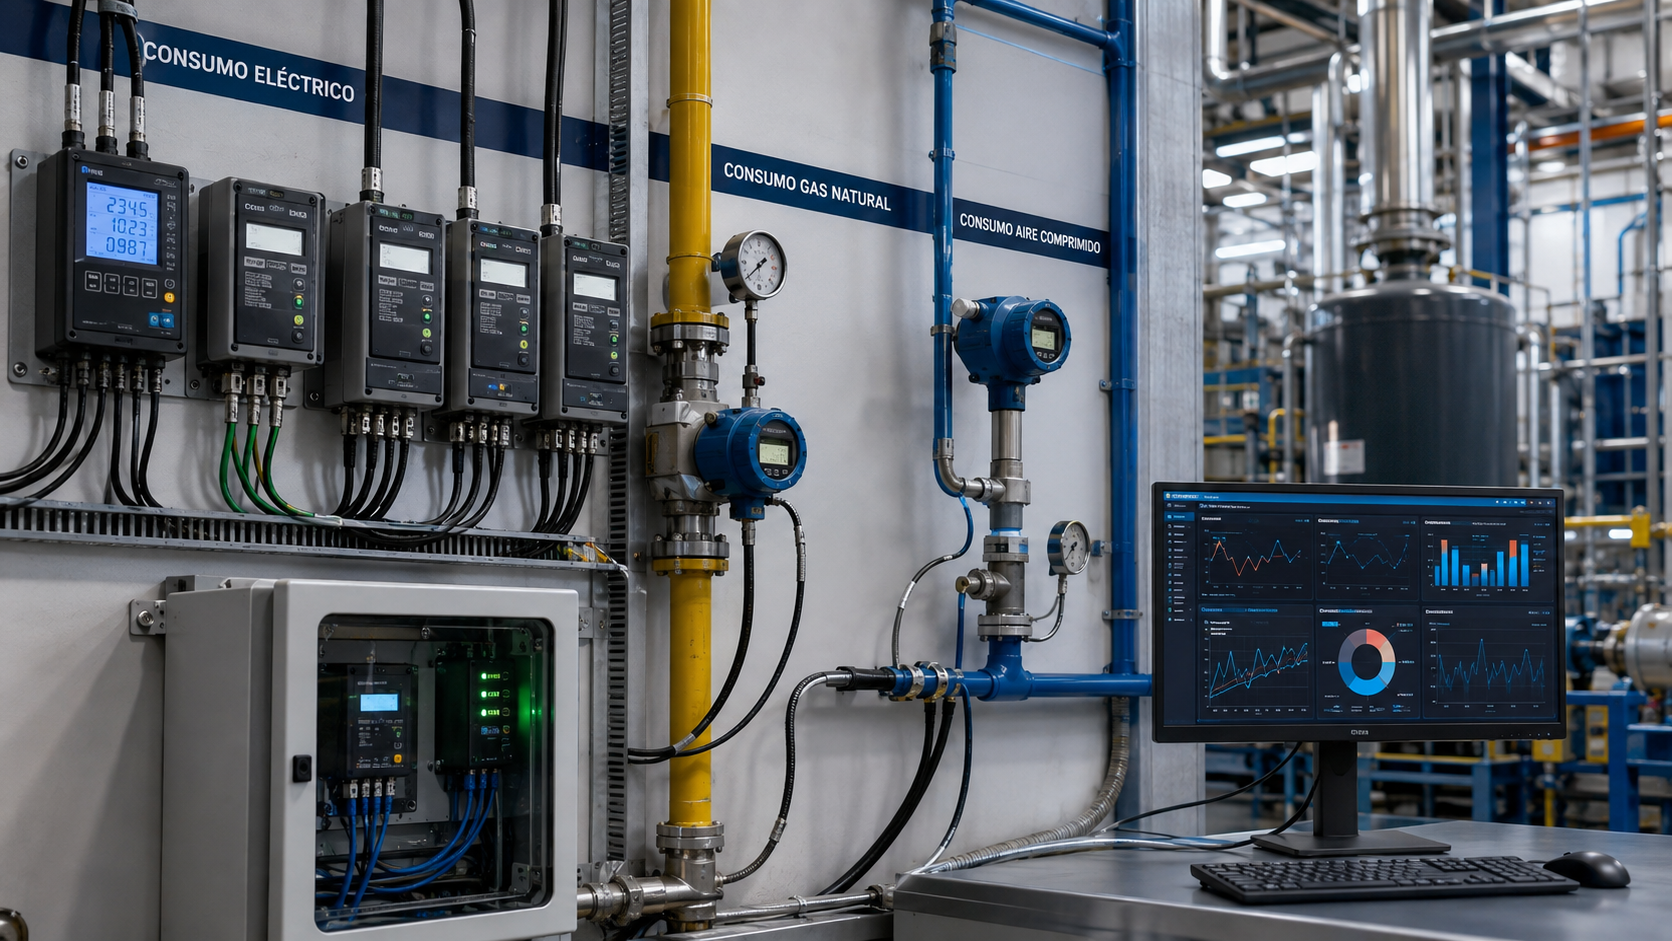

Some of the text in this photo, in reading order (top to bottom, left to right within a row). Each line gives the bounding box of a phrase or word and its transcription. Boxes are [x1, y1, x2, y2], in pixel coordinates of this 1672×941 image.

[143, 41, 355, 102] CONSUMO ELÉCTRICO
[724, 162, 892, 211] CONSUMO GAS NATURAL
[960, 213, 1101, 254] CONSUMO AIRE COMPRIMIDO
